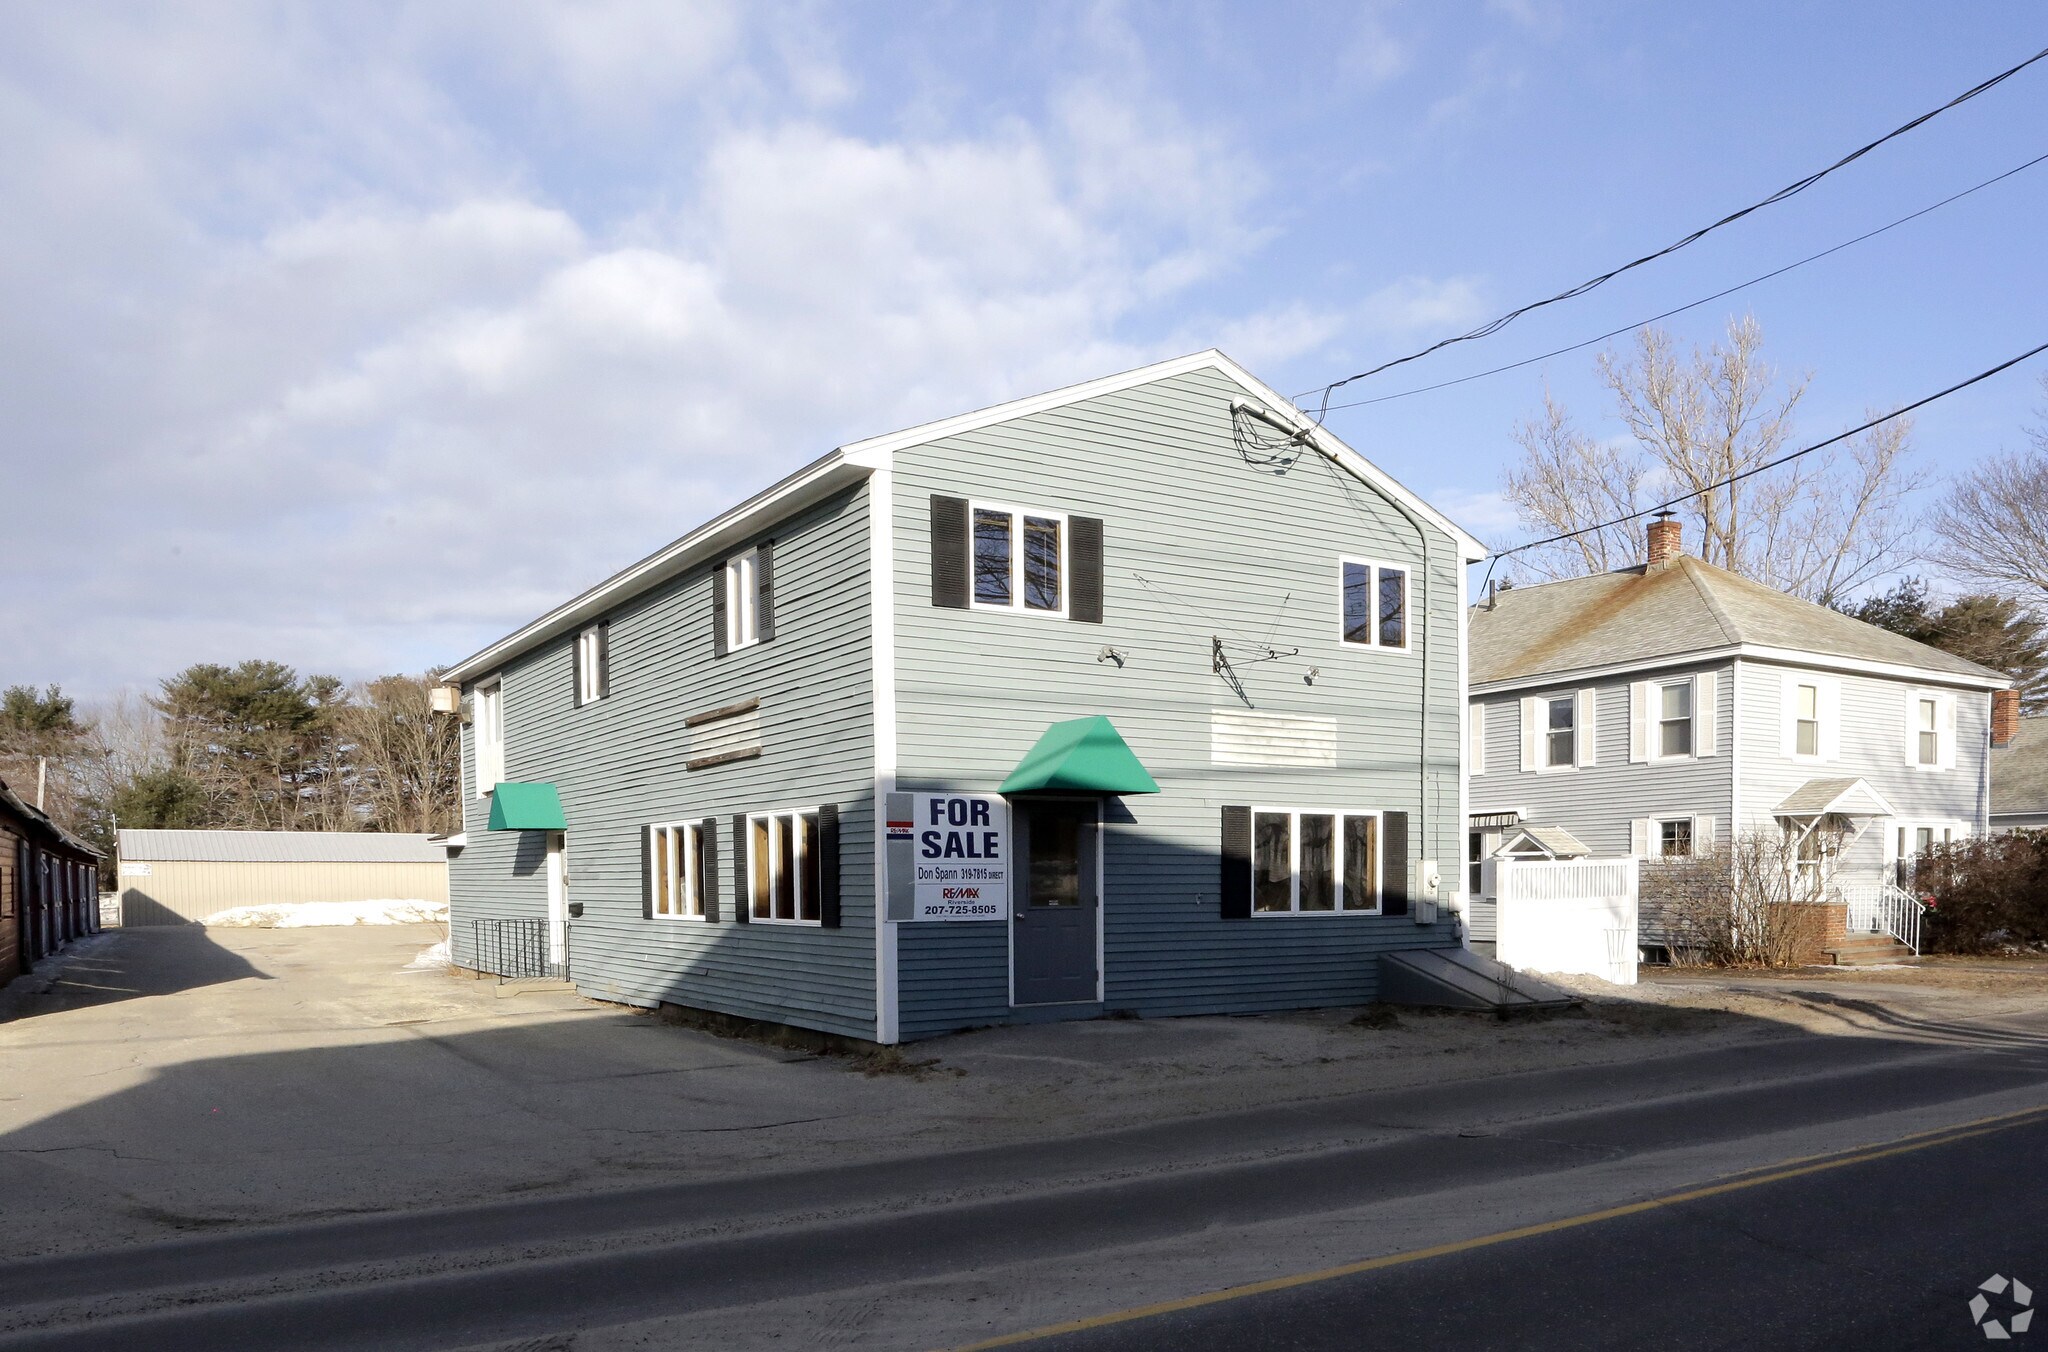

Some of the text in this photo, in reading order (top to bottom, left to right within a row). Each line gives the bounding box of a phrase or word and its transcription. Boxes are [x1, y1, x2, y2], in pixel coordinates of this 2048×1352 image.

[930, 798, 990, 826] FOR
[921, 831, 999, 858] SALE
[918, 866, 1004, 882] Don Spann 319-7815 DIRECT
[943, 887, 980, 899] RE/MAX
[925, 905, 996, 915] 207-725-8505
